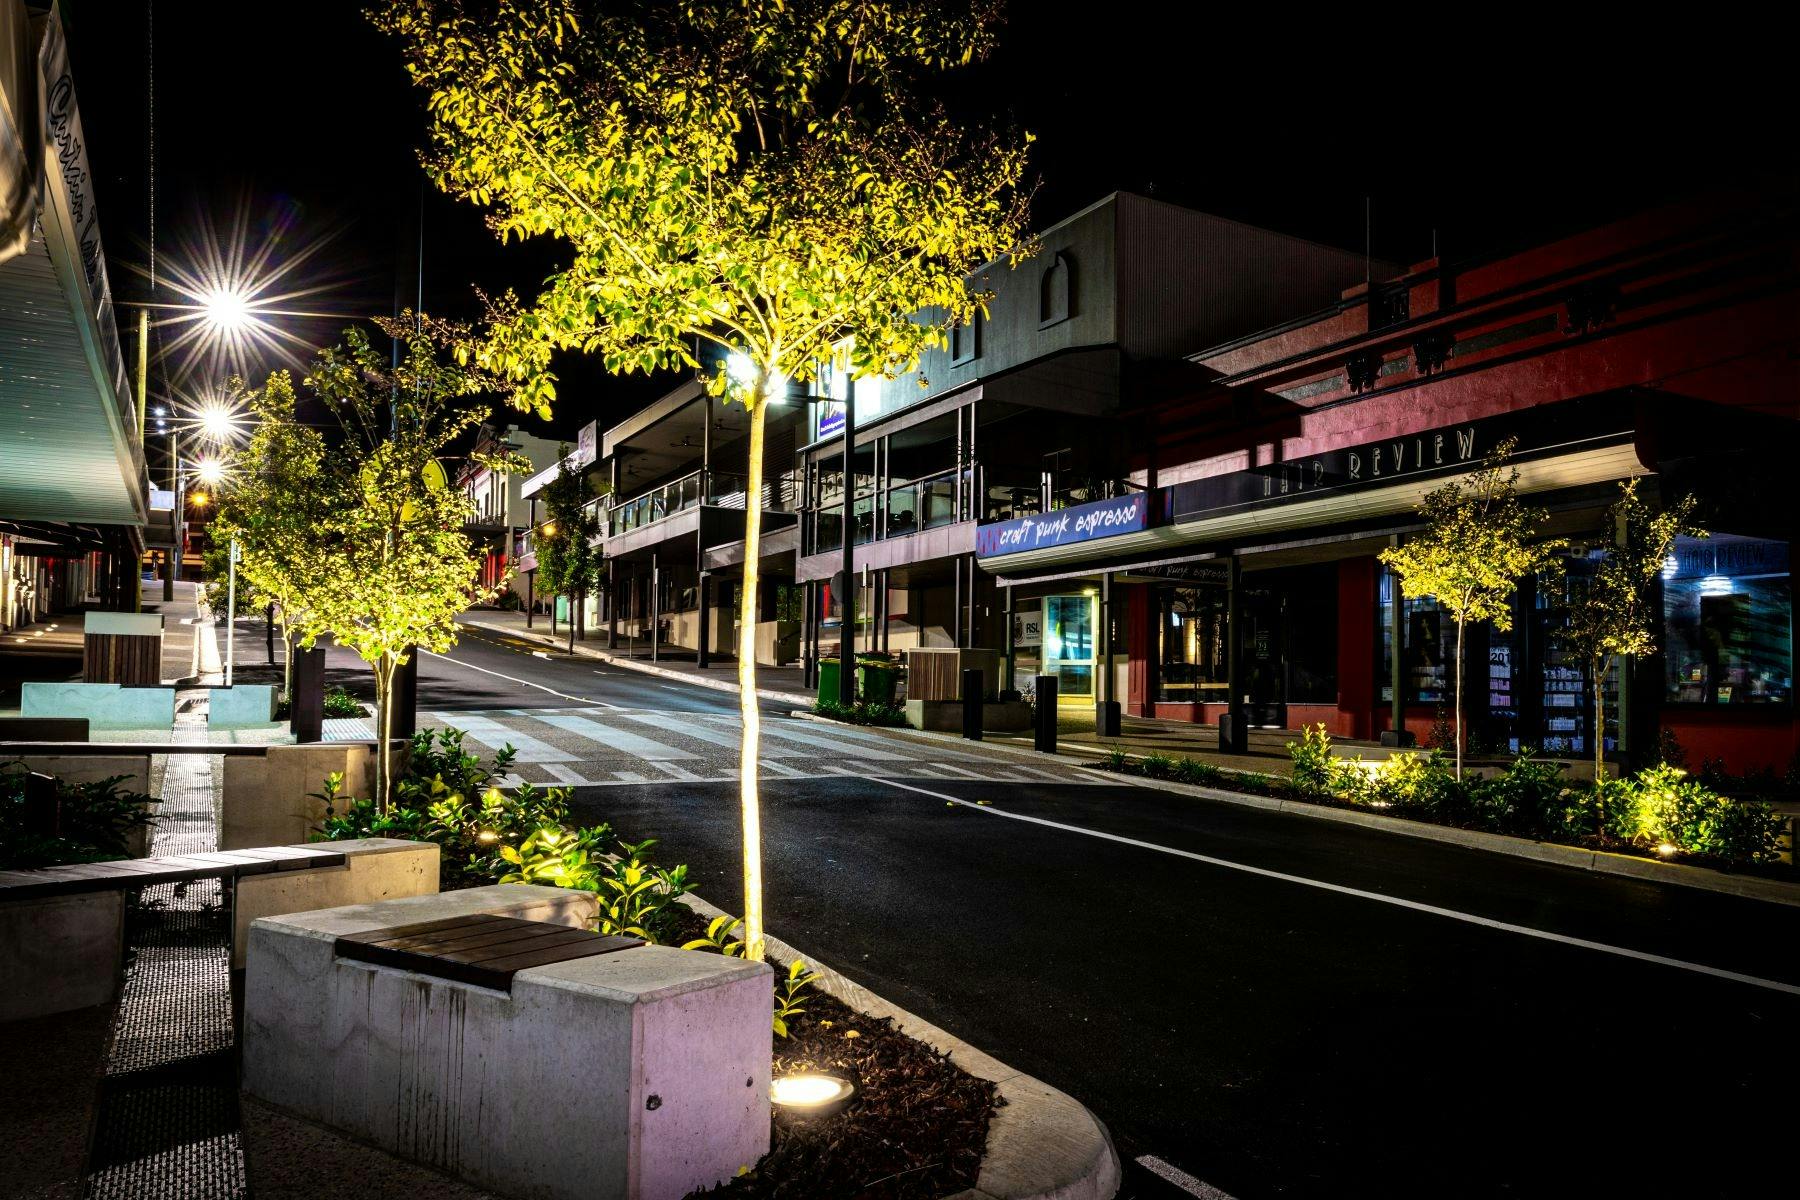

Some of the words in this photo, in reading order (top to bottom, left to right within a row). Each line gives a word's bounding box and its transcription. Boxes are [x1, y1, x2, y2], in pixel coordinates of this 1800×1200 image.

[1263, 461, 1323, 497] HAIR
[1349, 428, 1475, 480] REVIEW
[1000, 519, 1034, 545] craft
[1035, 513, 1071, 545] punk
[1075, 505, 1137, 536] espresso
[1684, 548, 1712, 571] HAIR
[1717, 543, 1765, 568] REVIEW
[1026, 622, 1040, 634] RSL
